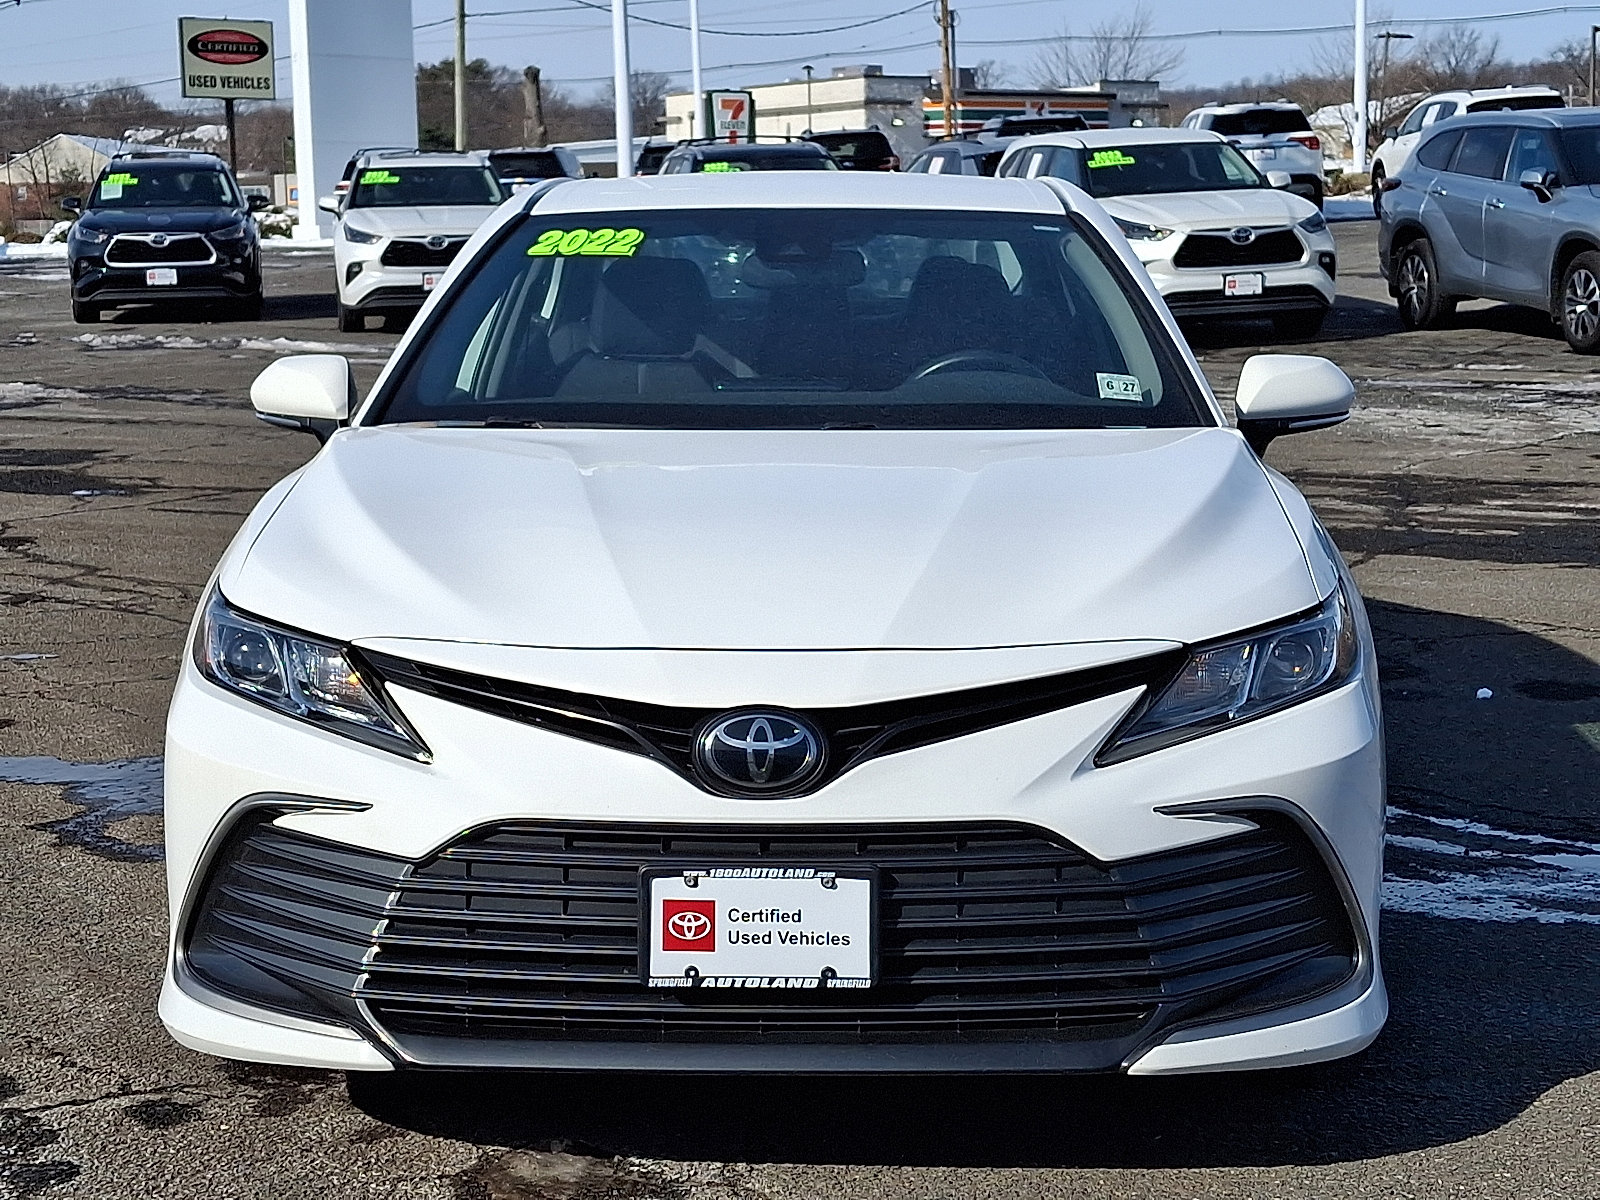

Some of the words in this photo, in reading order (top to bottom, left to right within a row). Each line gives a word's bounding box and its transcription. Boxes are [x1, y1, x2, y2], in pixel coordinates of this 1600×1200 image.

[188, 74, 217, 88] USED
[219, 76, 271, 90] VEHICLES
[527, 228, 645, 256] 2022
[1122, 382, 1135, 392] 27
[728, 908, 802, 922] Certified
[728, 930, 772, 945] Used
[777, 930, 851, 946] Vehicles
[648, 977, 693, 987] SPRINGFIELD
[700, 977, 820, 988] AUTOLAND
[826, 979, 872, 988] SPRINGFIELD
